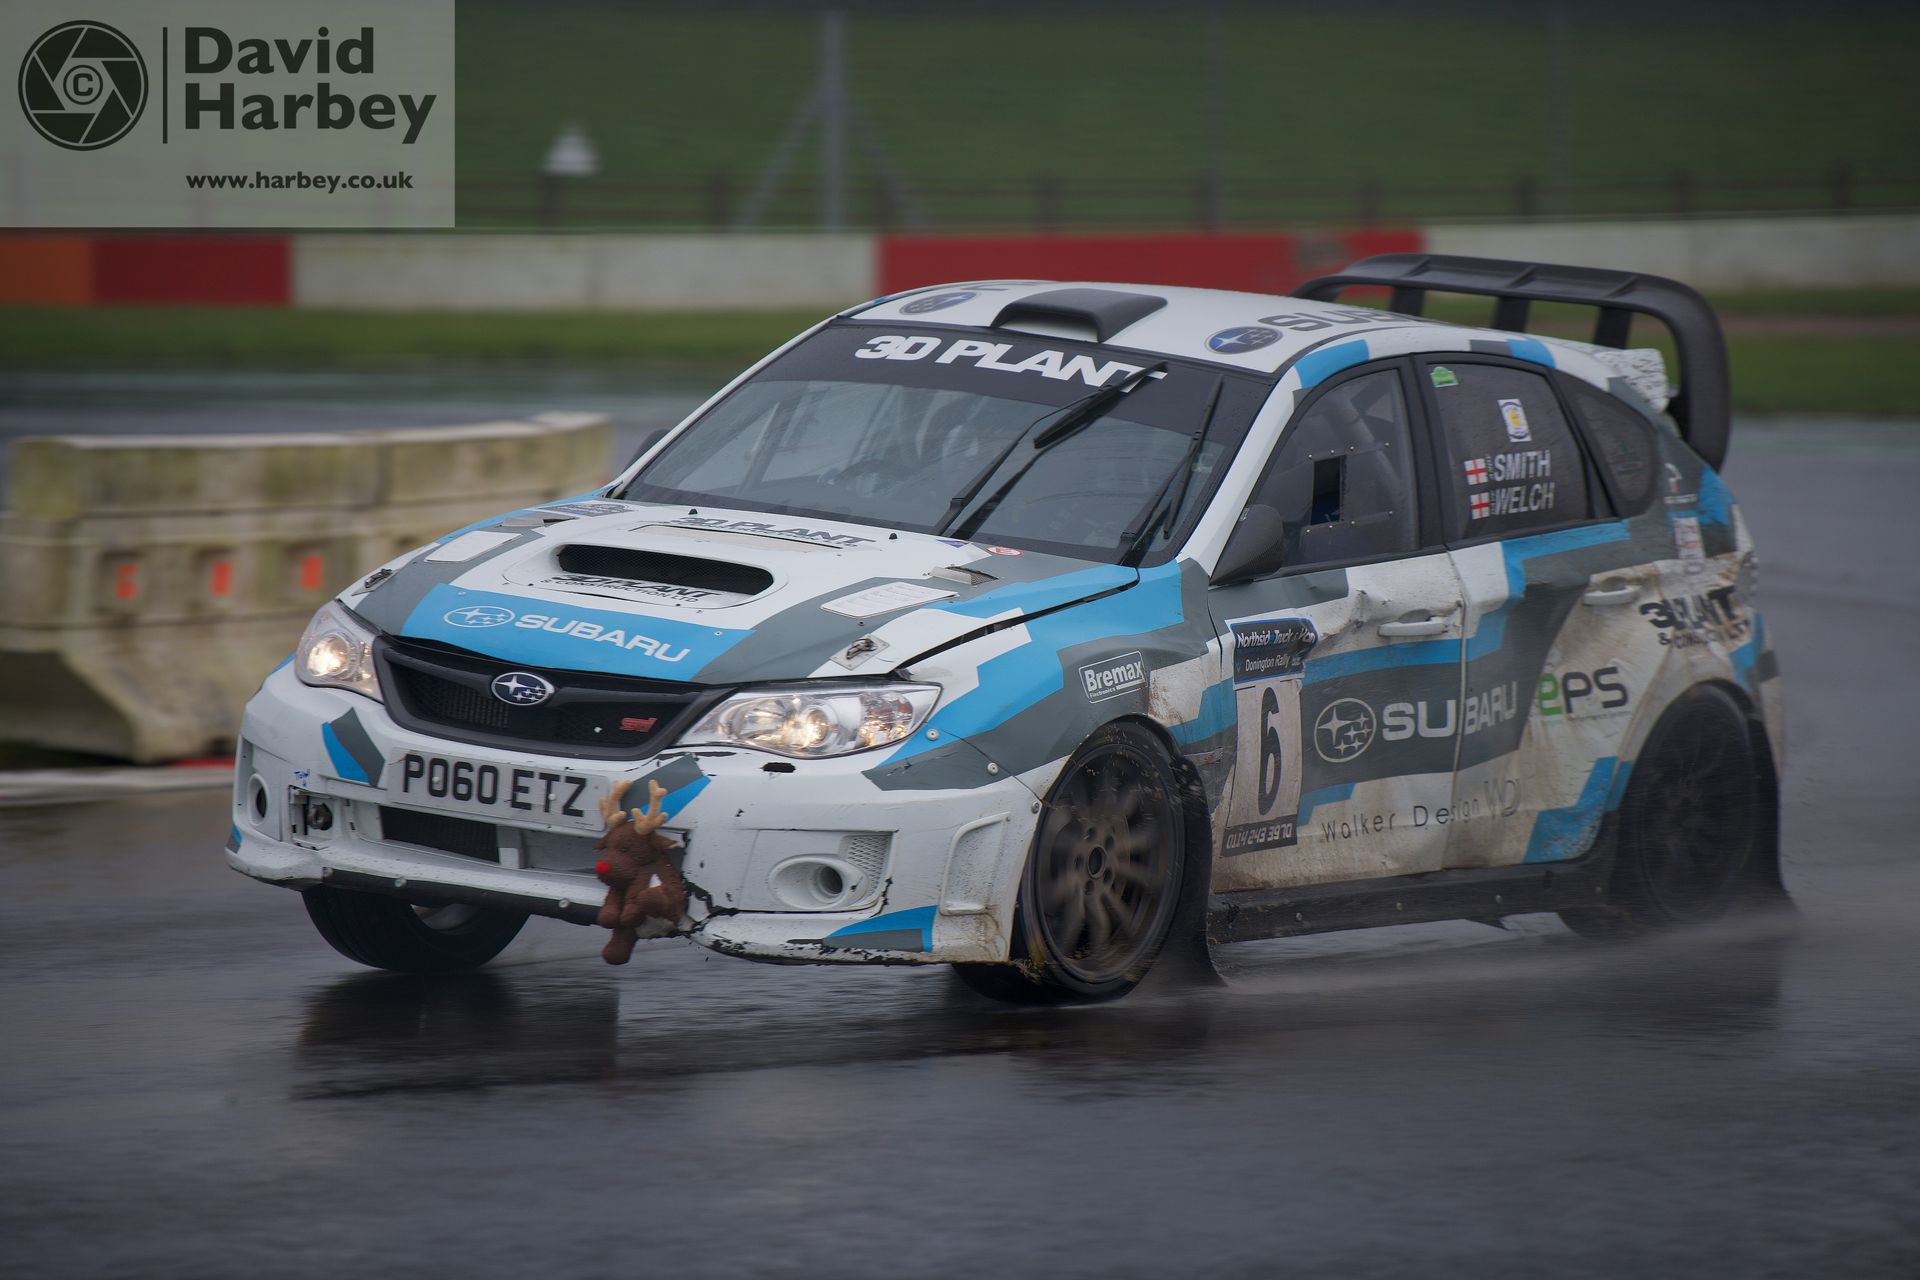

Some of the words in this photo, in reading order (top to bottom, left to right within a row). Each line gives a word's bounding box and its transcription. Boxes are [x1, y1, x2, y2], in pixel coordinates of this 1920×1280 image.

[855, 336, 943, 362] 3D
[935, 340, 1168, 393] PLANT
[1494, 450, 1551, 481] SMITH
[1496, 482, 1555, 515] WELCH
[726, 521, 876, 544] PLANT
[555, 580, 667, 598] CONSTRUCTION
[670, 594, 699, 603] LTD
[604, 579, 722, 598] PLANT
[514, 614, 691, 662] SUBARU
[1237, 629, 1274, 648] Northsid
[1084, 661, 1146, 692] Bremax
[1245, 656, 1275, 672] Donington
[1275, 653, 1291, 668] Rally
[1089, 687, 1116, 698] Electronics
[1382, 681, 1517, 741] SUBARU
[1258, 687, 1281, 816] 6
[511, 769, 587, 817] ETZ
[1226, 831, 1248, 848] 0114
[1247, 827, 1266, 845] 243
[1267, 823, 1293, 841] 3970
[1322, 813, 1396, 843] Walker
[1413, 798, 1480, 827] Design
